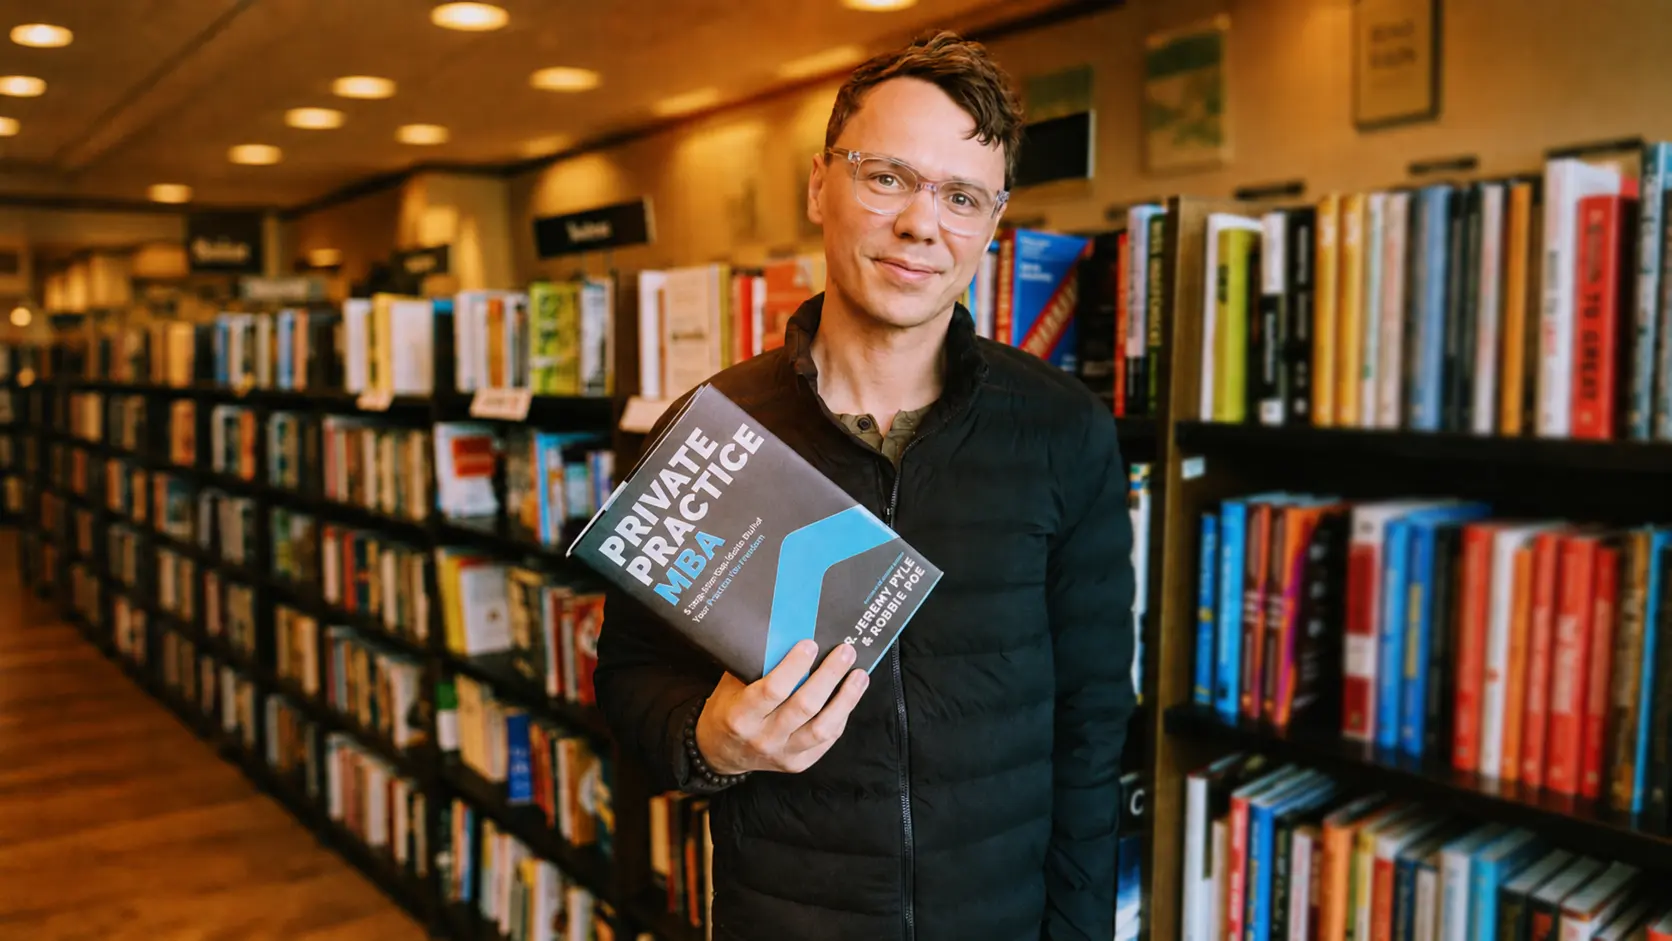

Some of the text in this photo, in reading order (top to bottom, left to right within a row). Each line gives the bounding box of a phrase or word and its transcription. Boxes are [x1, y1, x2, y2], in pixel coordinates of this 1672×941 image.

[598, 427, 719, 567] PRIVATE
[625, 423, 764, 586] PRACTICE
[653, 530, 725, 606] MBA
[844, 636, 857, 645] R.
[854, 586, 892, 635] JEREMY
[889, 556, 915, 588] PYLE
[861, 636, 873, 647] &
[870, 590, 907, 636] ROBBIE
[904, 566, 925, 591] POE
